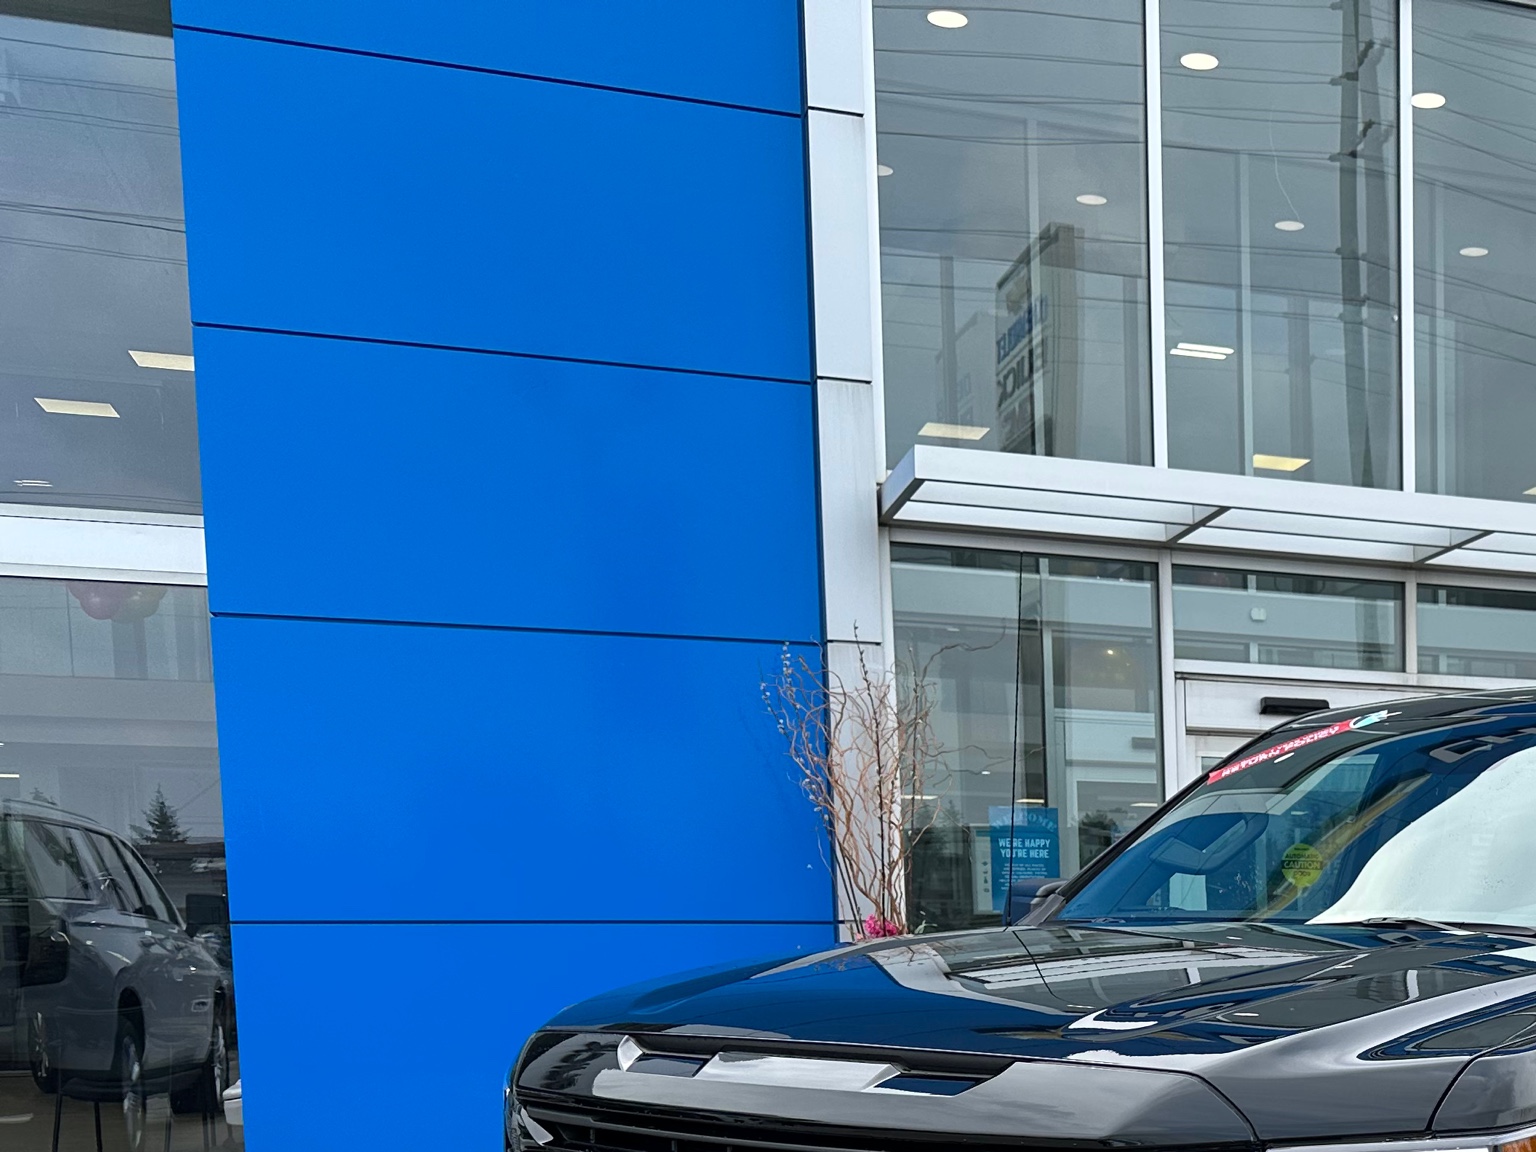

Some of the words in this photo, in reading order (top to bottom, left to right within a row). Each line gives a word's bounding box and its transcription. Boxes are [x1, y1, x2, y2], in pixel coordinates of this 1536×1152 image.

[998, 838, 1023, 848] WERE
[1025, 838, 1050, 848] HAPPY
[1030, 849, 1050, 859] HERE
[1284, 860, 1321, 869] CAUTION
